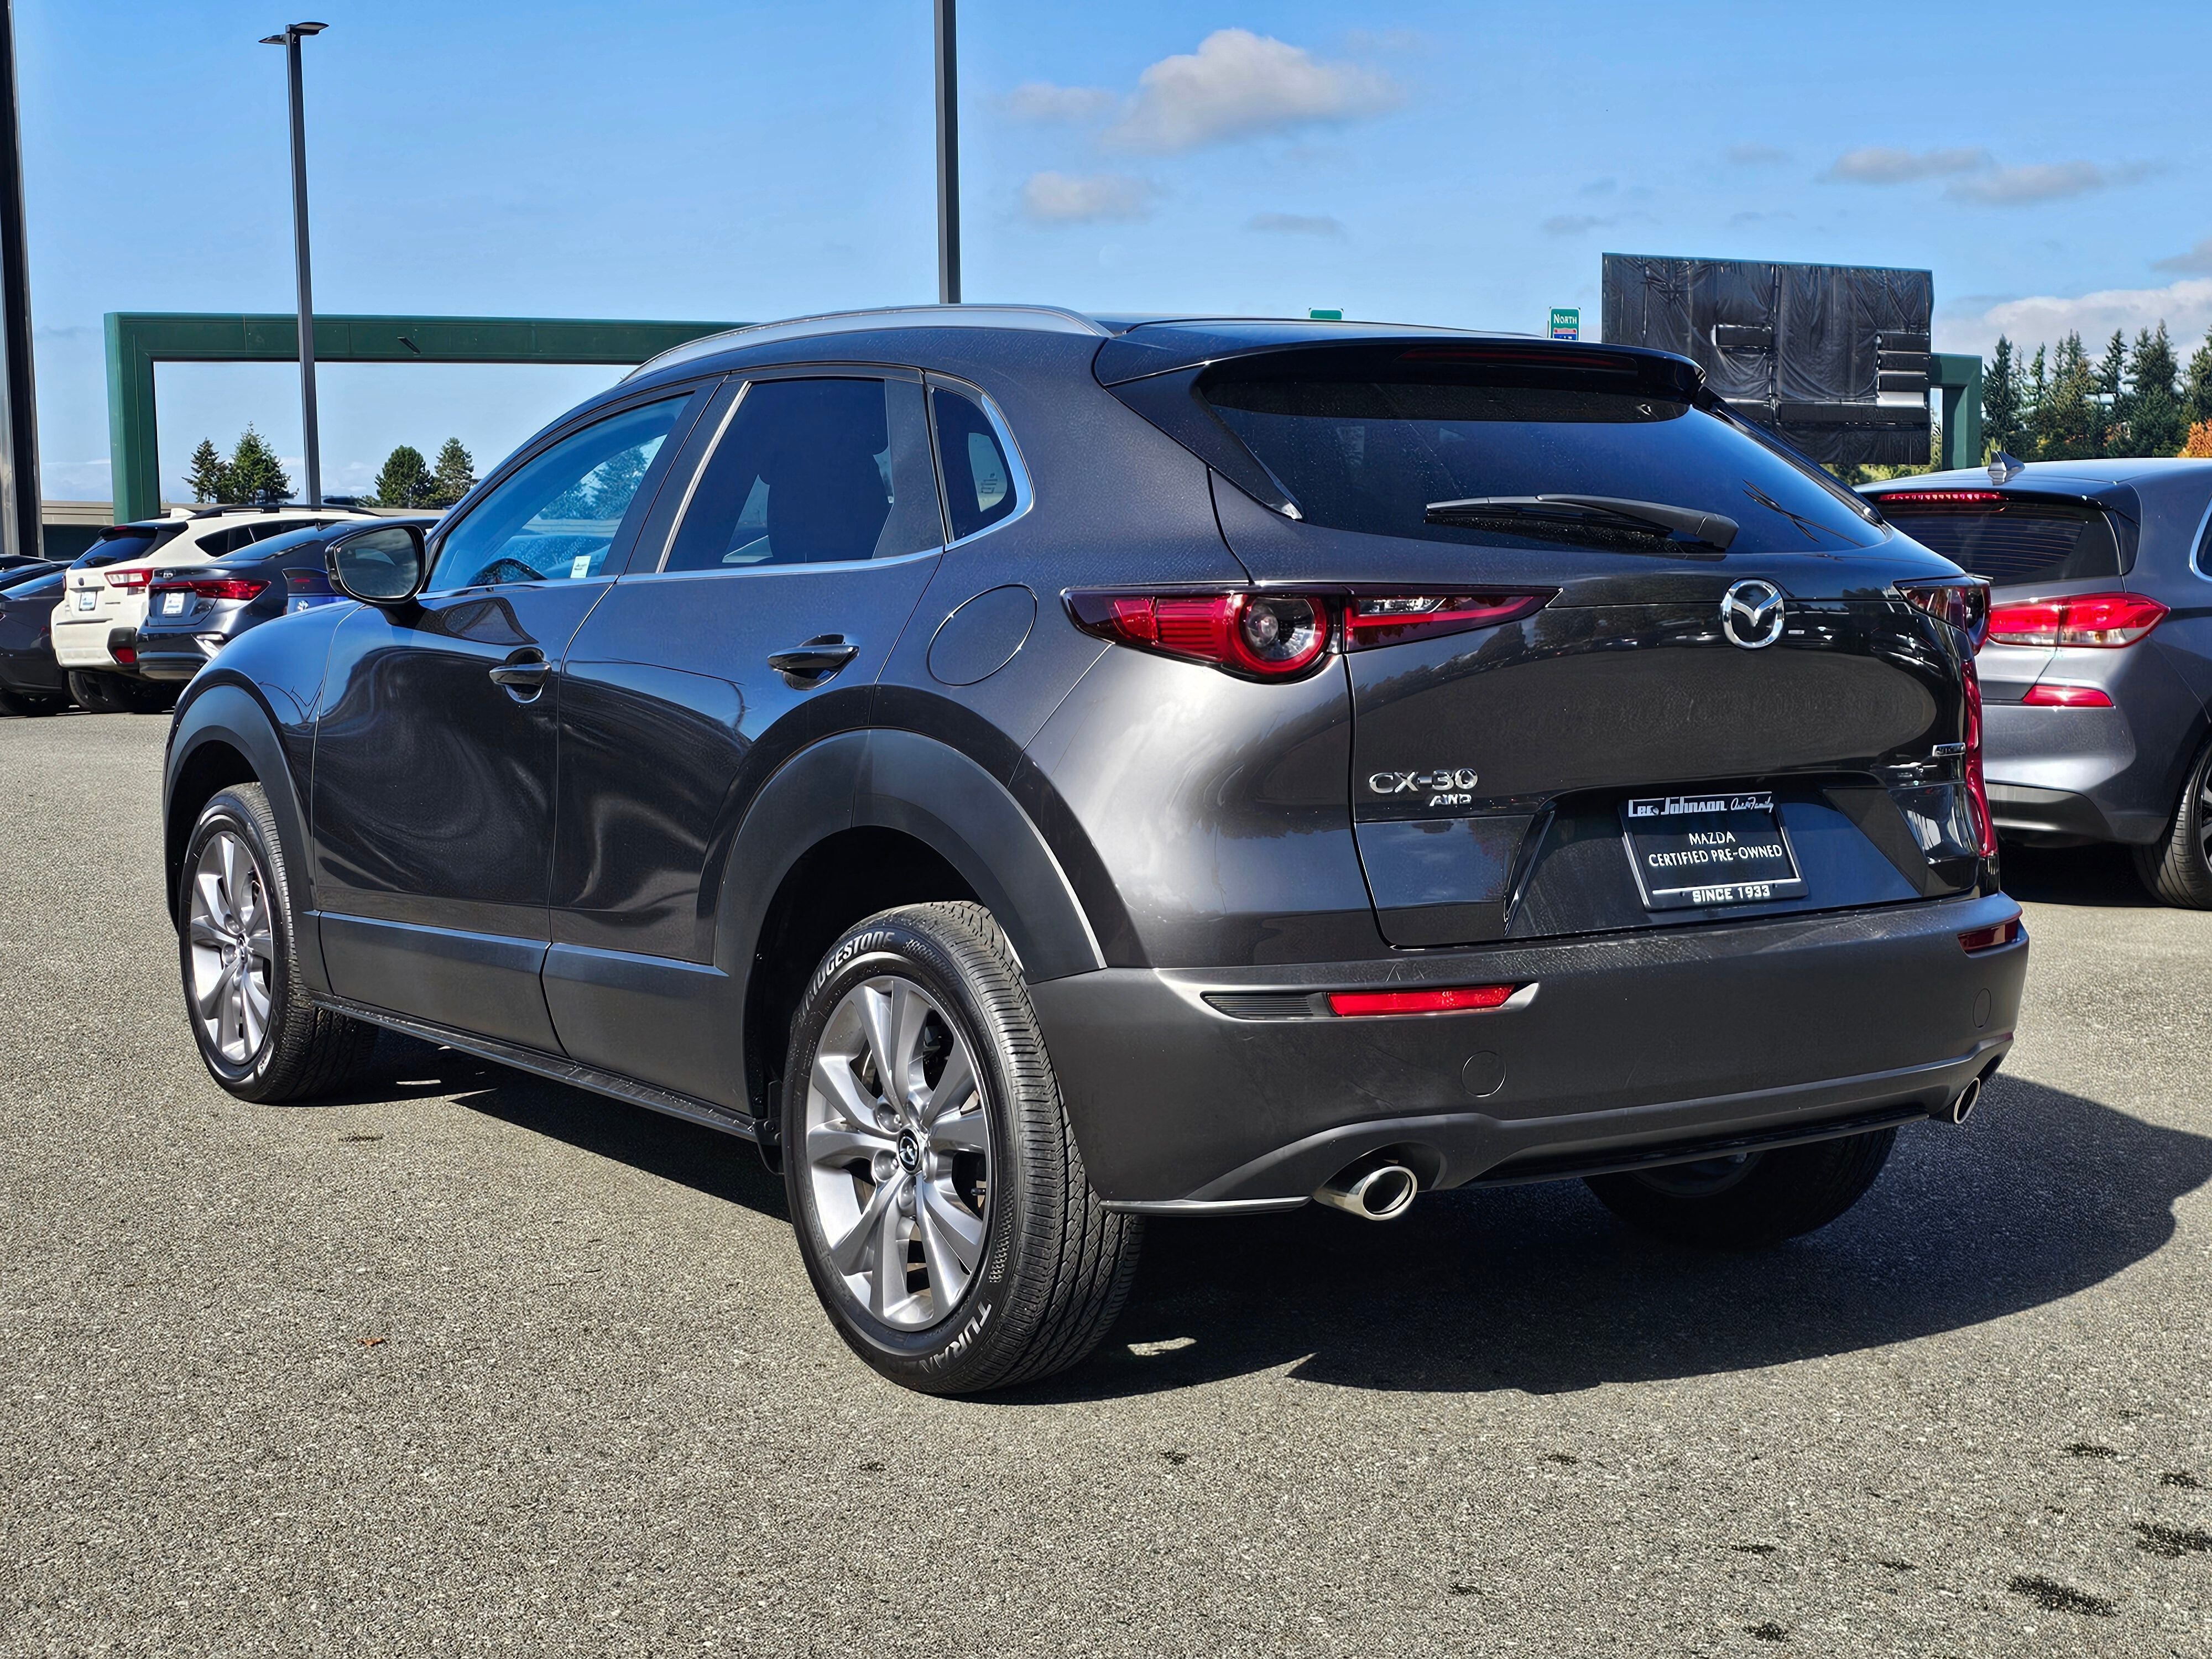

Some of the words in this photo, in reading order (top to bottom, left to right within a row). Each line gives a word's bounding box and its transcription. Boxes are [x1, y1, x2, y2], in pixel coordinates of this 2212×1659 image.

[1369, 768, 1478, 794] CX-30
[1661, 796, 1728, 816] Johnson
[1688, 831, 1736, 846] MAZDA
[1648, 849, 1709, 867] CERTIFIED
[1711, 844, 1782, 862] PRE-OWNED
[1692, 888, 1733, 902] SINCE
[1738, 885, 1770, 899] 1933
[887, 1301, 992, 1376] TURAN
